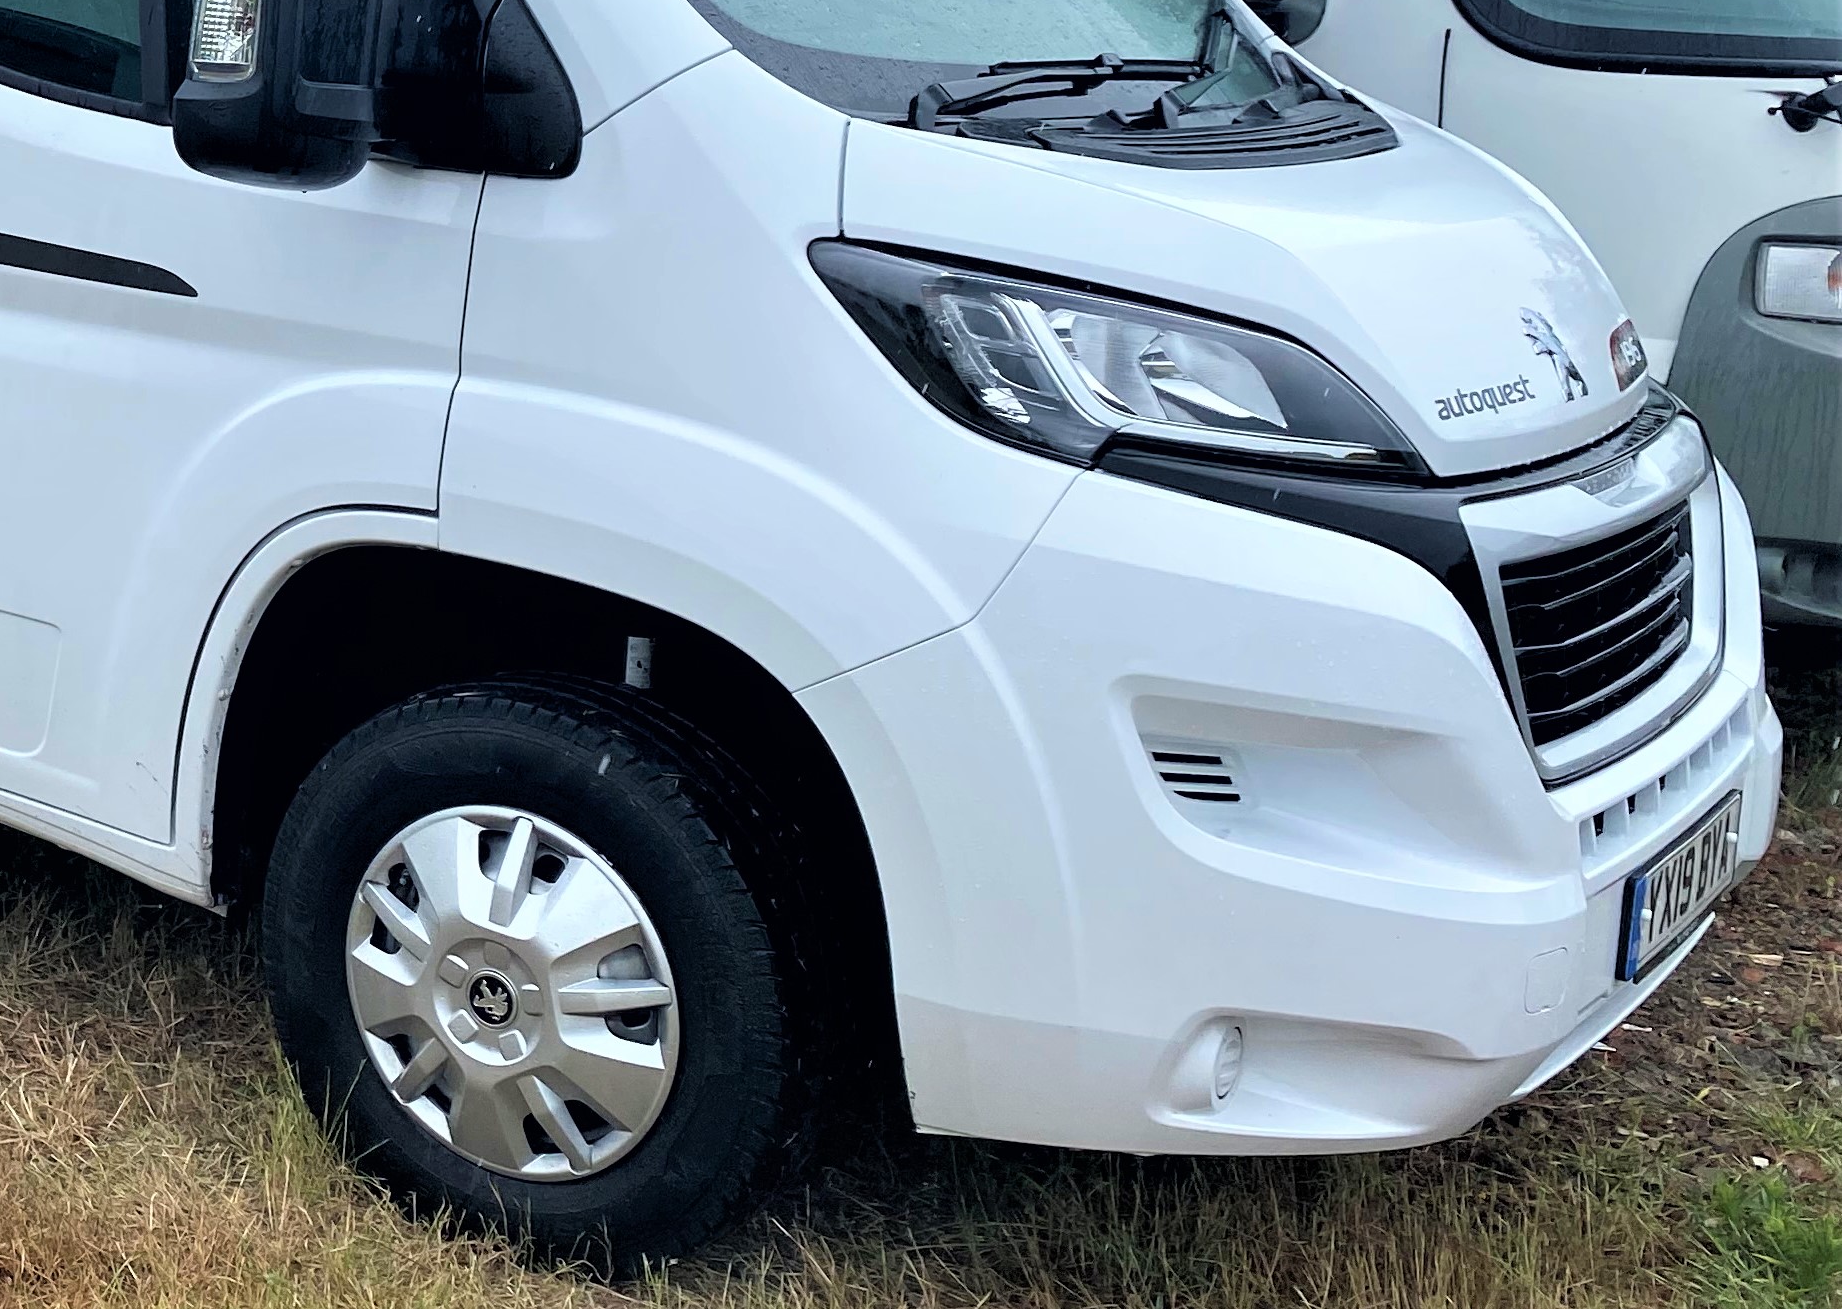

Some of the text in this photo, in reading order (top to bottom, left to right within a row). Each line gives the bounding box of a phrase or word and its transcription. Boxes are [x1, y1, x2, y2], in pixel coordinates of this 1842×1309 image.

[1434, 373, 1536, 421] autoquest
[1649, 846, 1696, 943] YX19
[1695, 811, 1731, 901] BYA
